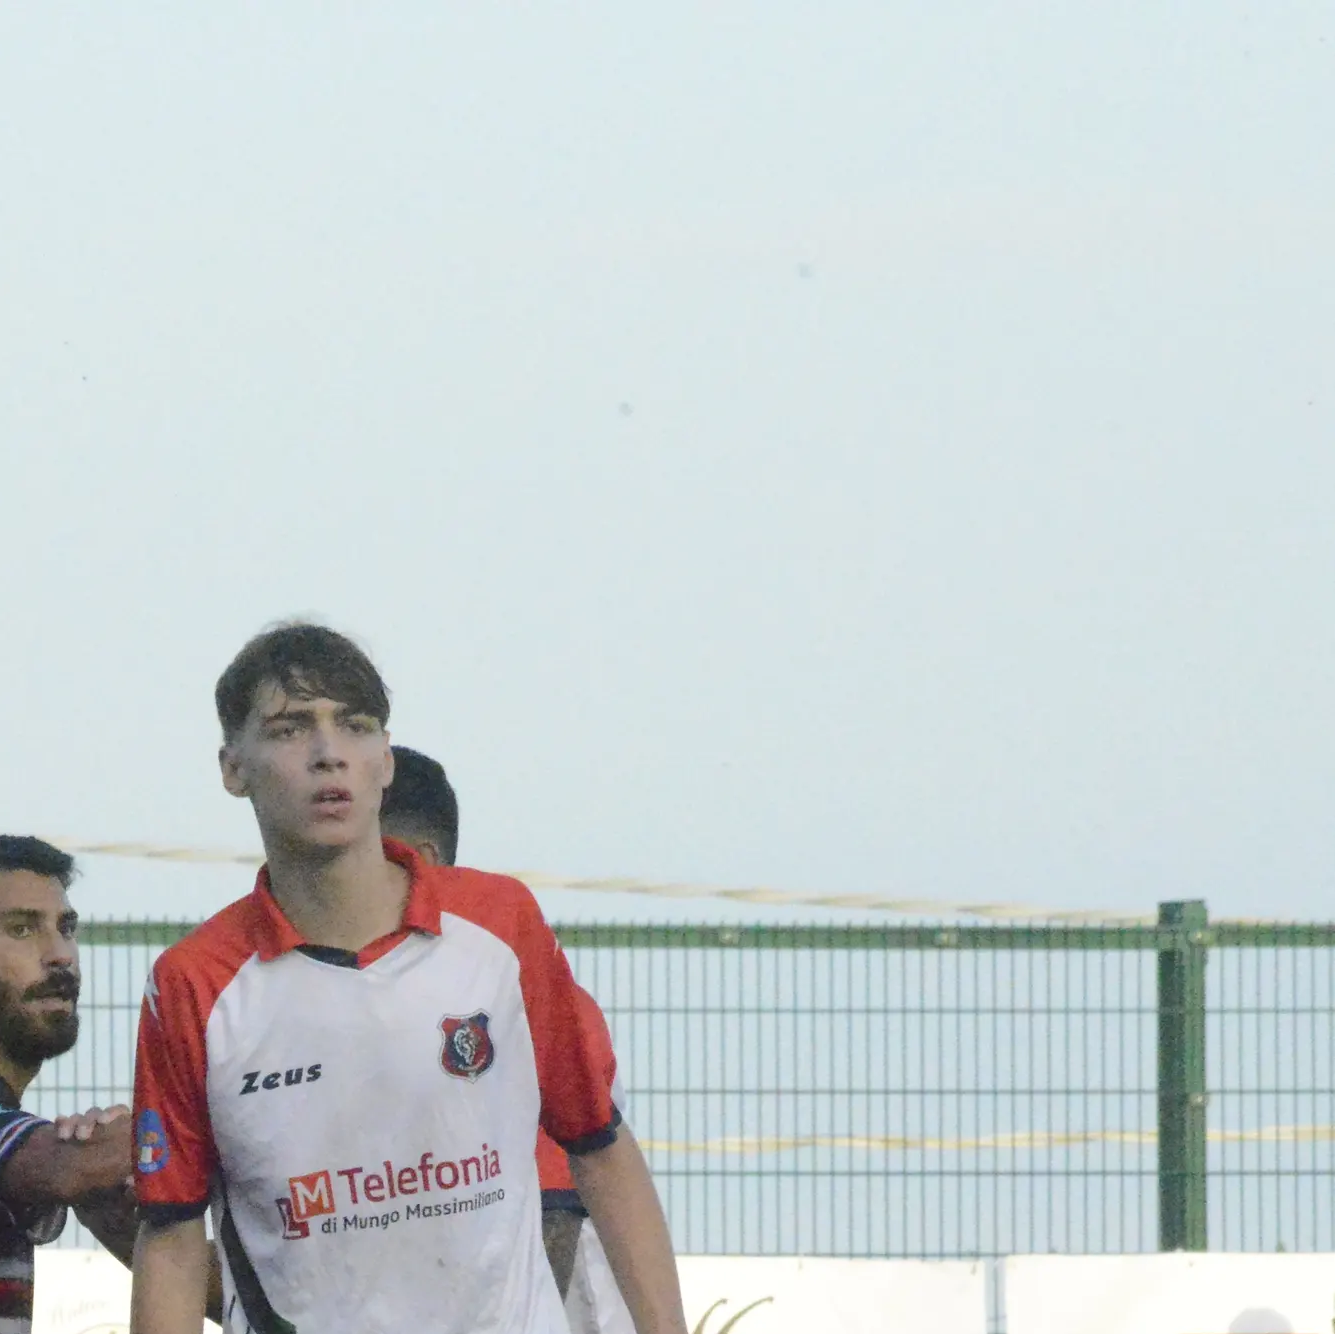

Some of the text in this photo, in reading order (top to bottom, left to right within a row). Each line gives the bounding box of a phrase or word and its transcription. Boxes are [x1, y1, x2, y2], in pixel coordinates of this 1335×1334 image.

[239, 1064, 322, 1096] Zeus
[336, 1143, 502, 1204] Telefonia
[321, 1188, 506, 1234] di Mungo Massimiliano
